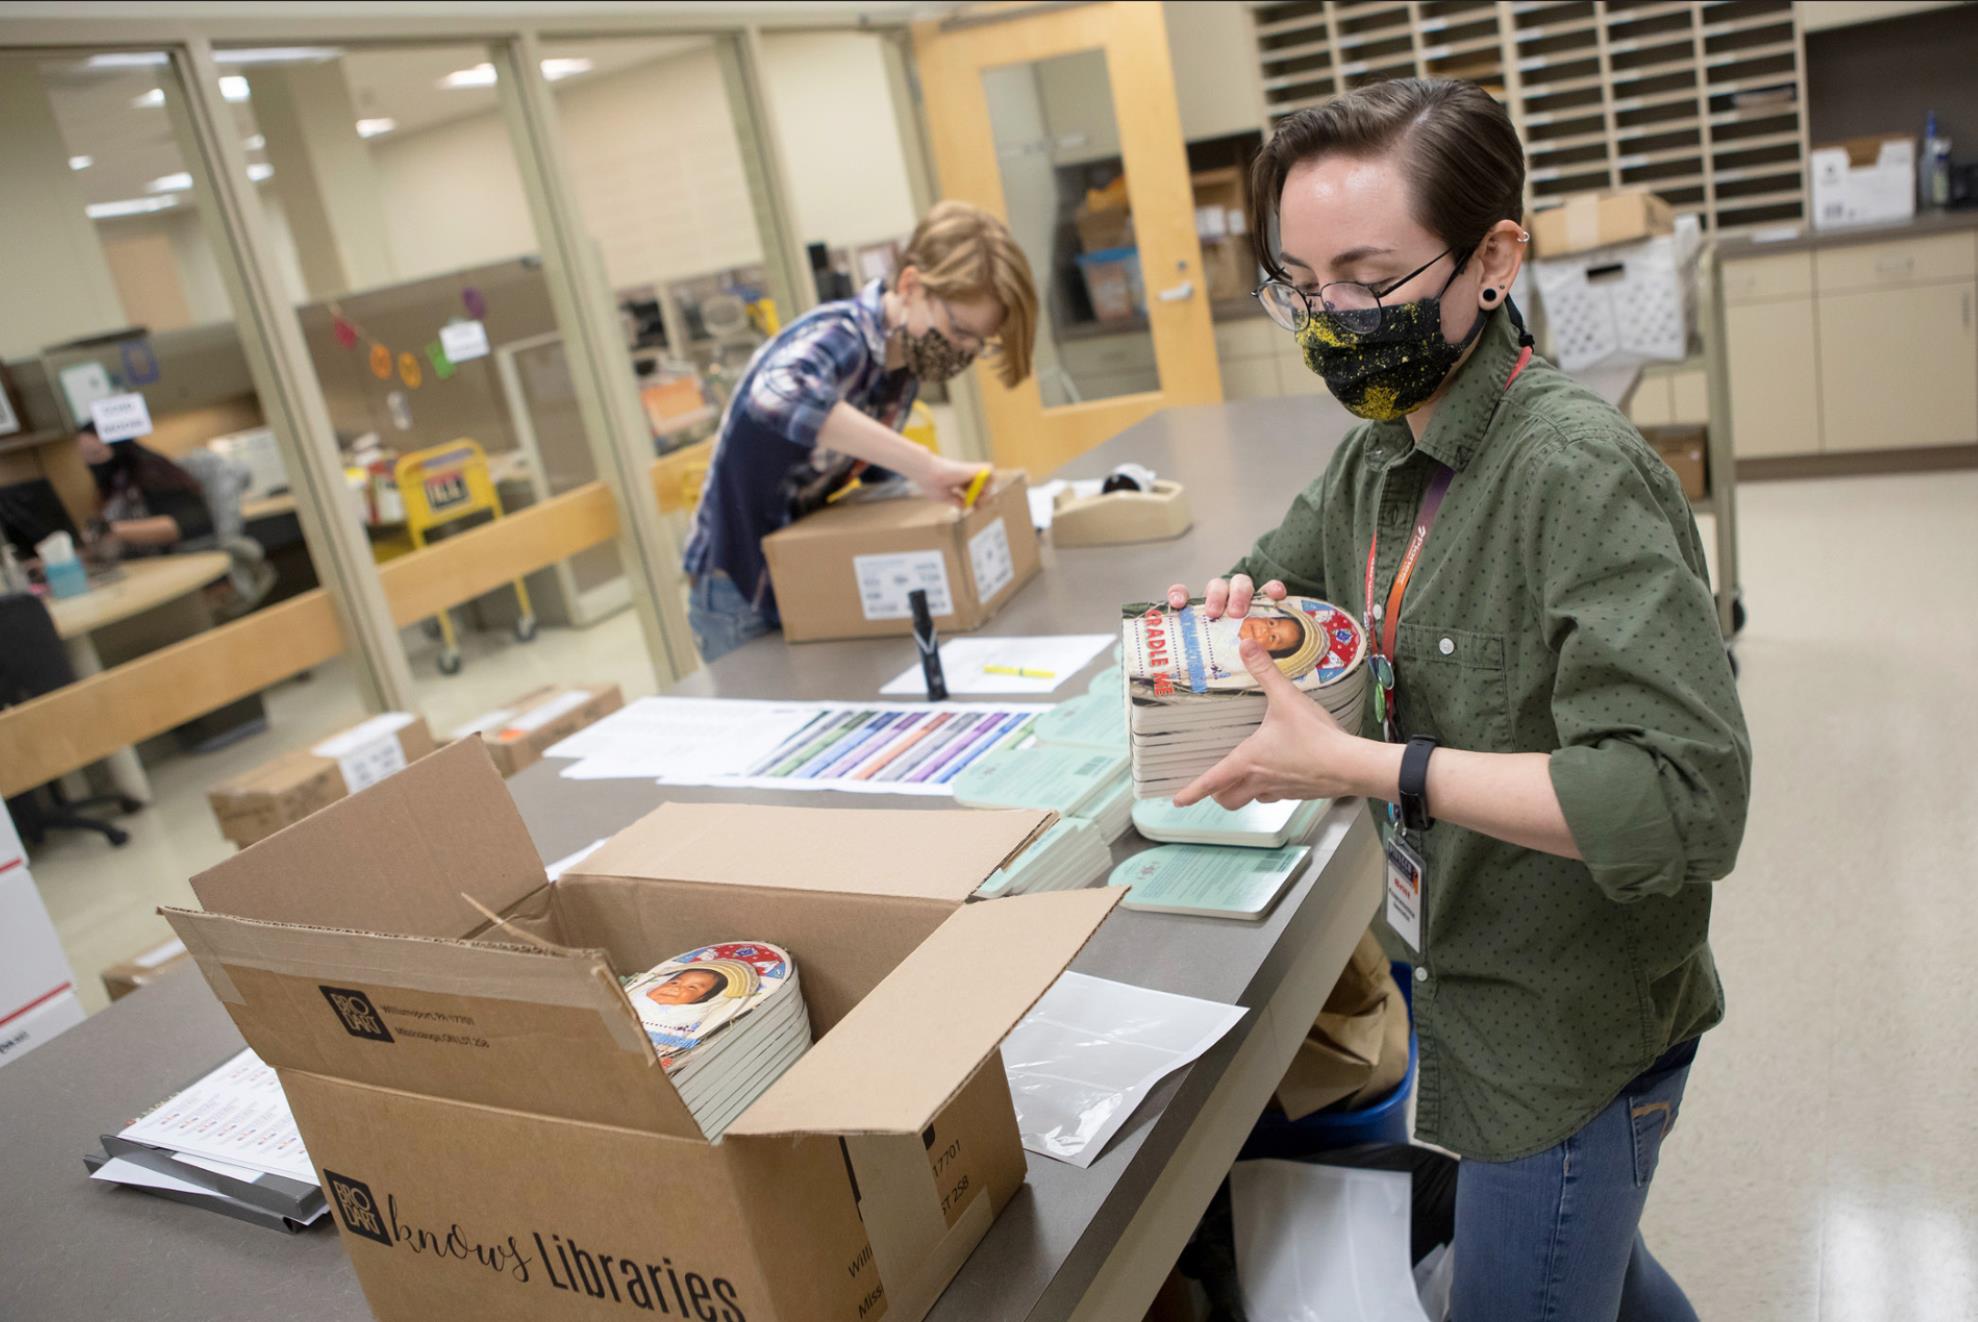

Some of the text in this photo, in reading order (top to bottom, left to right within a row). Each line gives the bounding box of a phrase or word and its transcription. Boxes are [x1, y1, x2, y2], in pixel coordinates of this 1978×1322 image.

[1144, 609, 1175, 697] CRADLE ME
[932, 1139, 962, 1177] 17701
[333, 1180, 371, 1212] BRO
[344, 1204, 381, 1236] DART
[388, 1193, 747, 1322] knows Libraries
